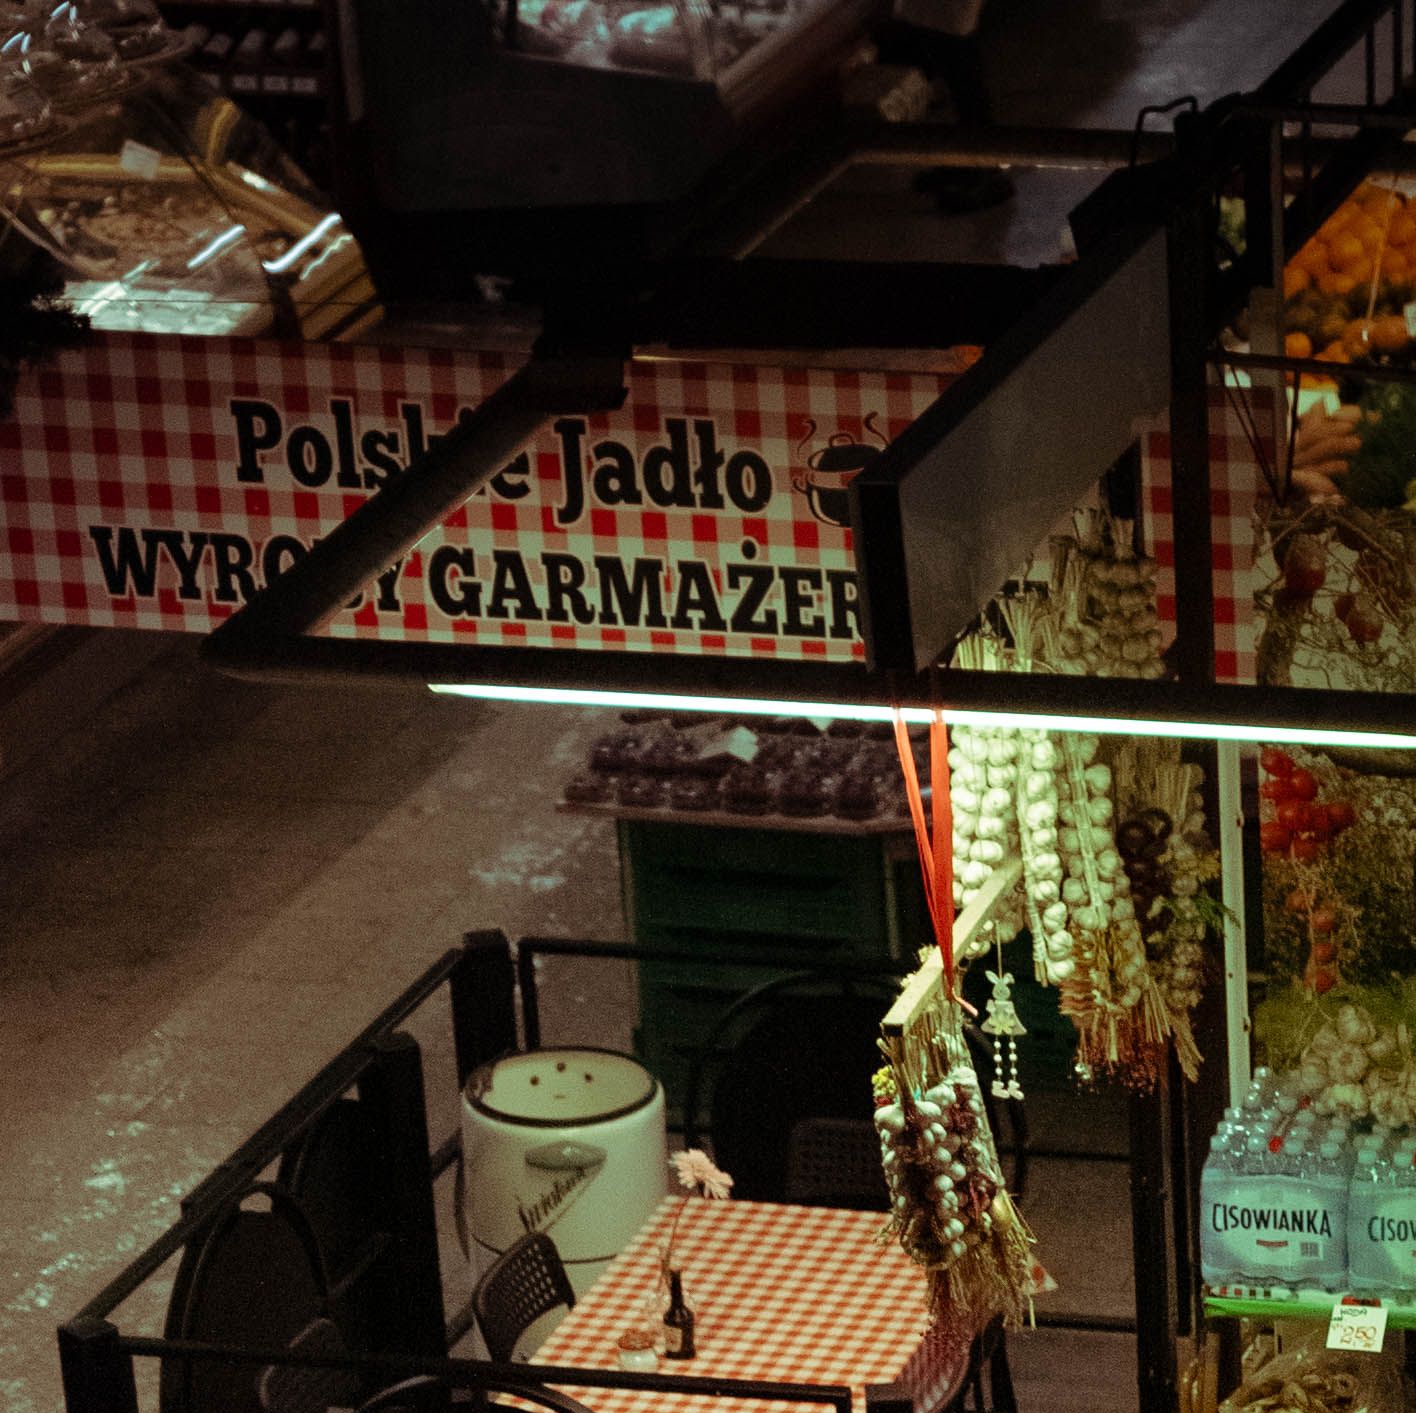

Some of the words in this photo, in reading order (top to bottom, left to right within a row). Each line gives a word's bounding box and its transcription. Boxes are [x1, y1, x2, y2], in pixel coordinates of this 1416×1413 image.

[230, 400, 529, 502] Polske
[553, 419, 772, 526] Jadło
[90, 526, 403, 613] WYROY
[1212, 1203, 1332, 1237] CISOWIANKA
